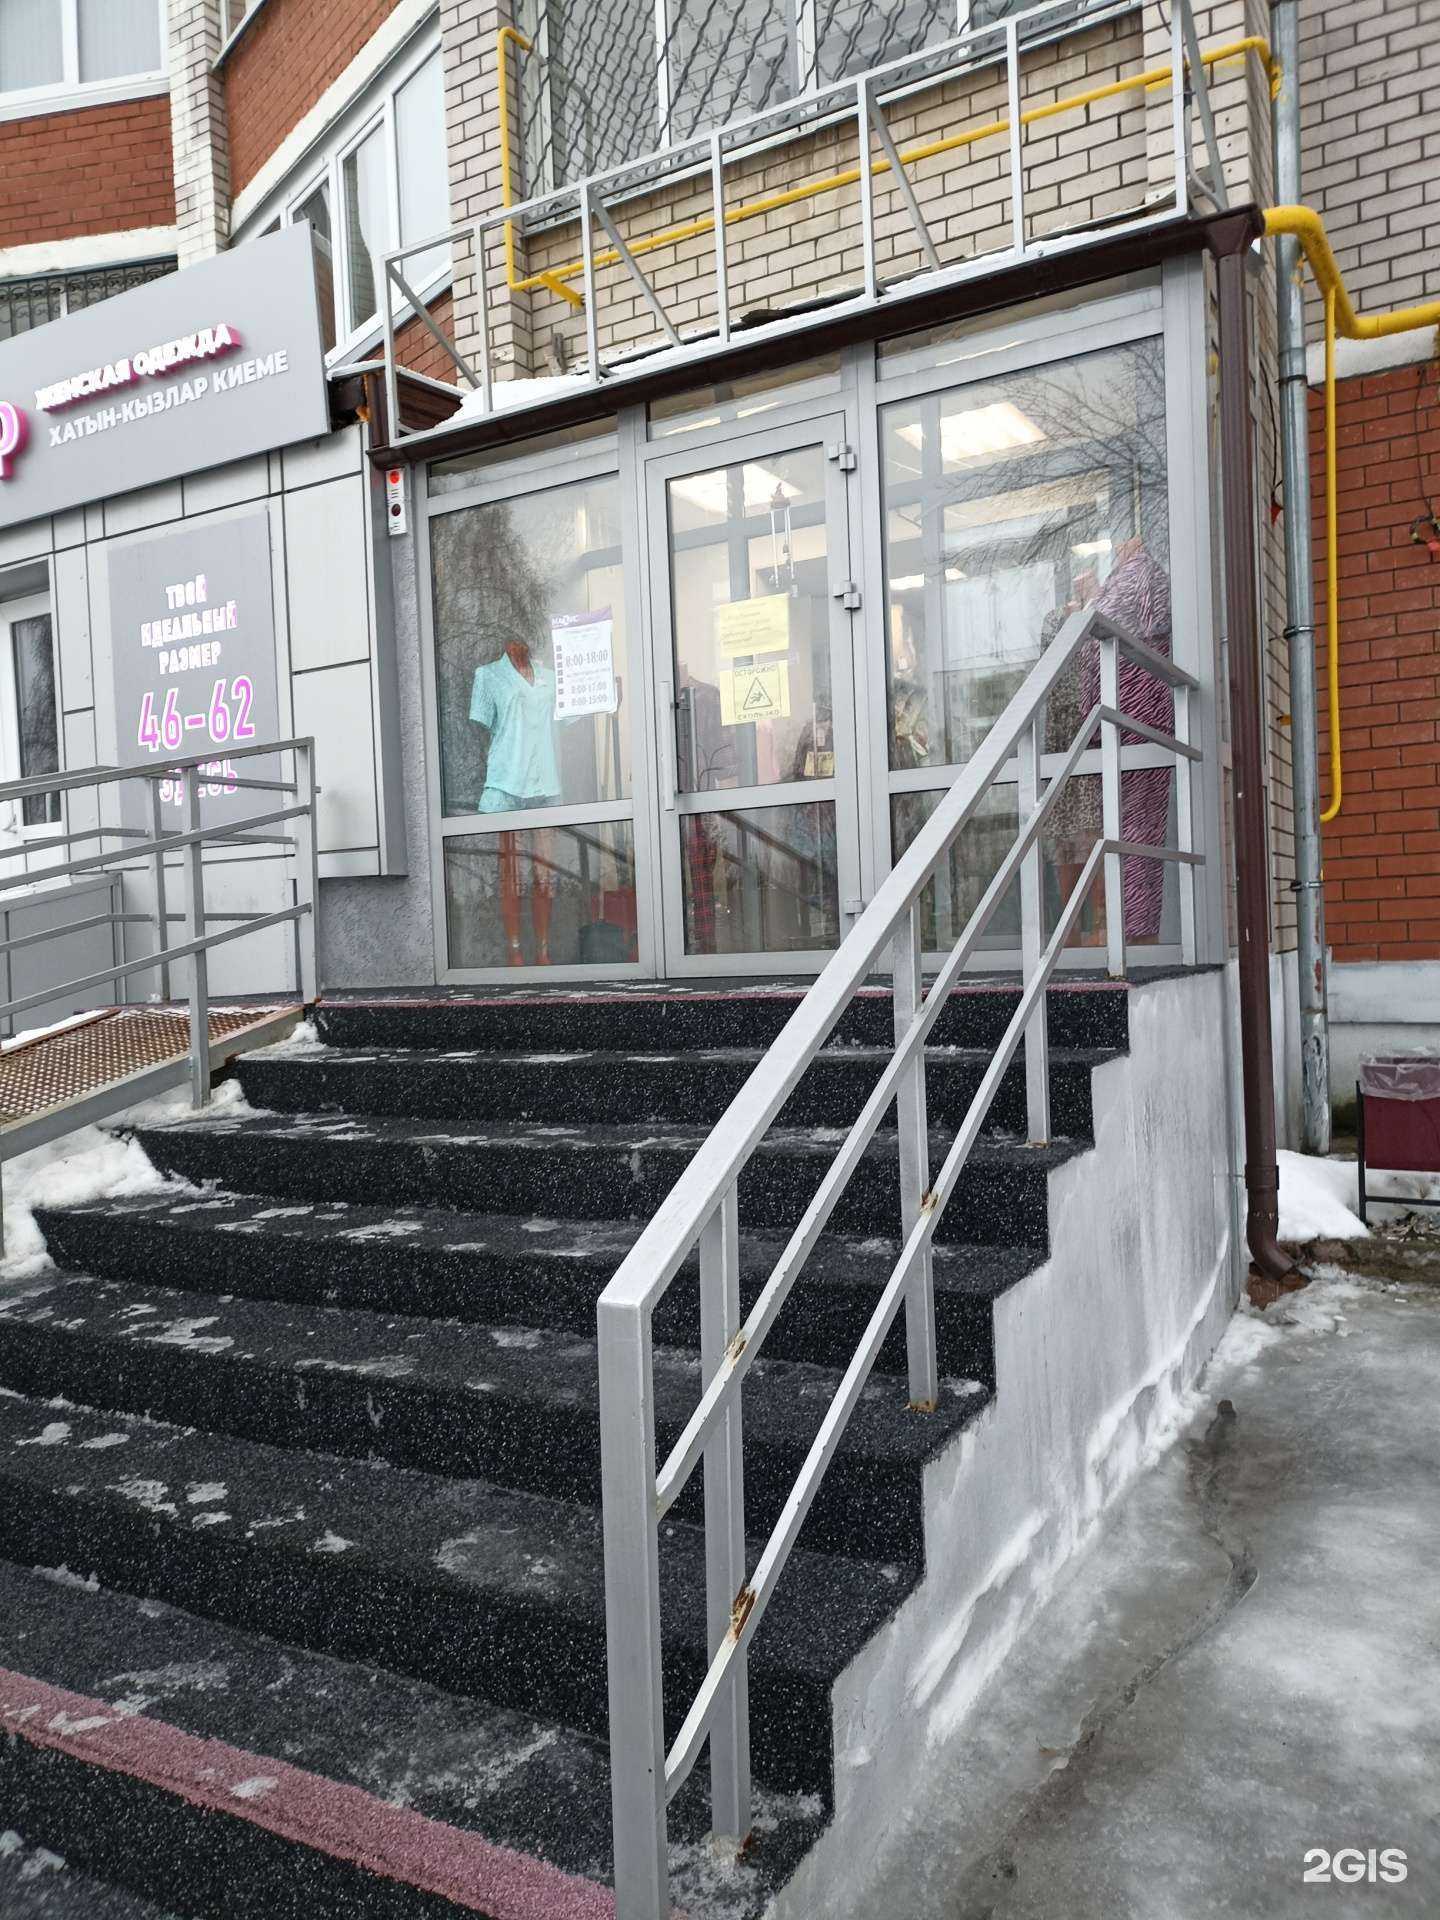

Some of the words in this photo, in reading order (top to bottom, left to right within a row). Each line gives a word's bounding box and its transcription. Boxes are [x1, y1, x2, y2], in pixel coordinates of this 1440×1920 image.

[34, 358, 132, 411] ЖЕНСКАЯ
[132, 323, 234, 376] ОДЕЖДА
[48, 378, 209, 447] ХАТЫН-КЫЗЛАР
[213, 350, 289, 394] КИЕМЕ
[165, 574, 207, 609] ТВОЙ
[140, 600, 238, 647] ИДЕАЛЬНЫЙ
[158, 641, 222, 674] РАЗМЕР
[137, 674, 256, 753] 46-62
[158, 758, 239, 806] ЗДСЬ
